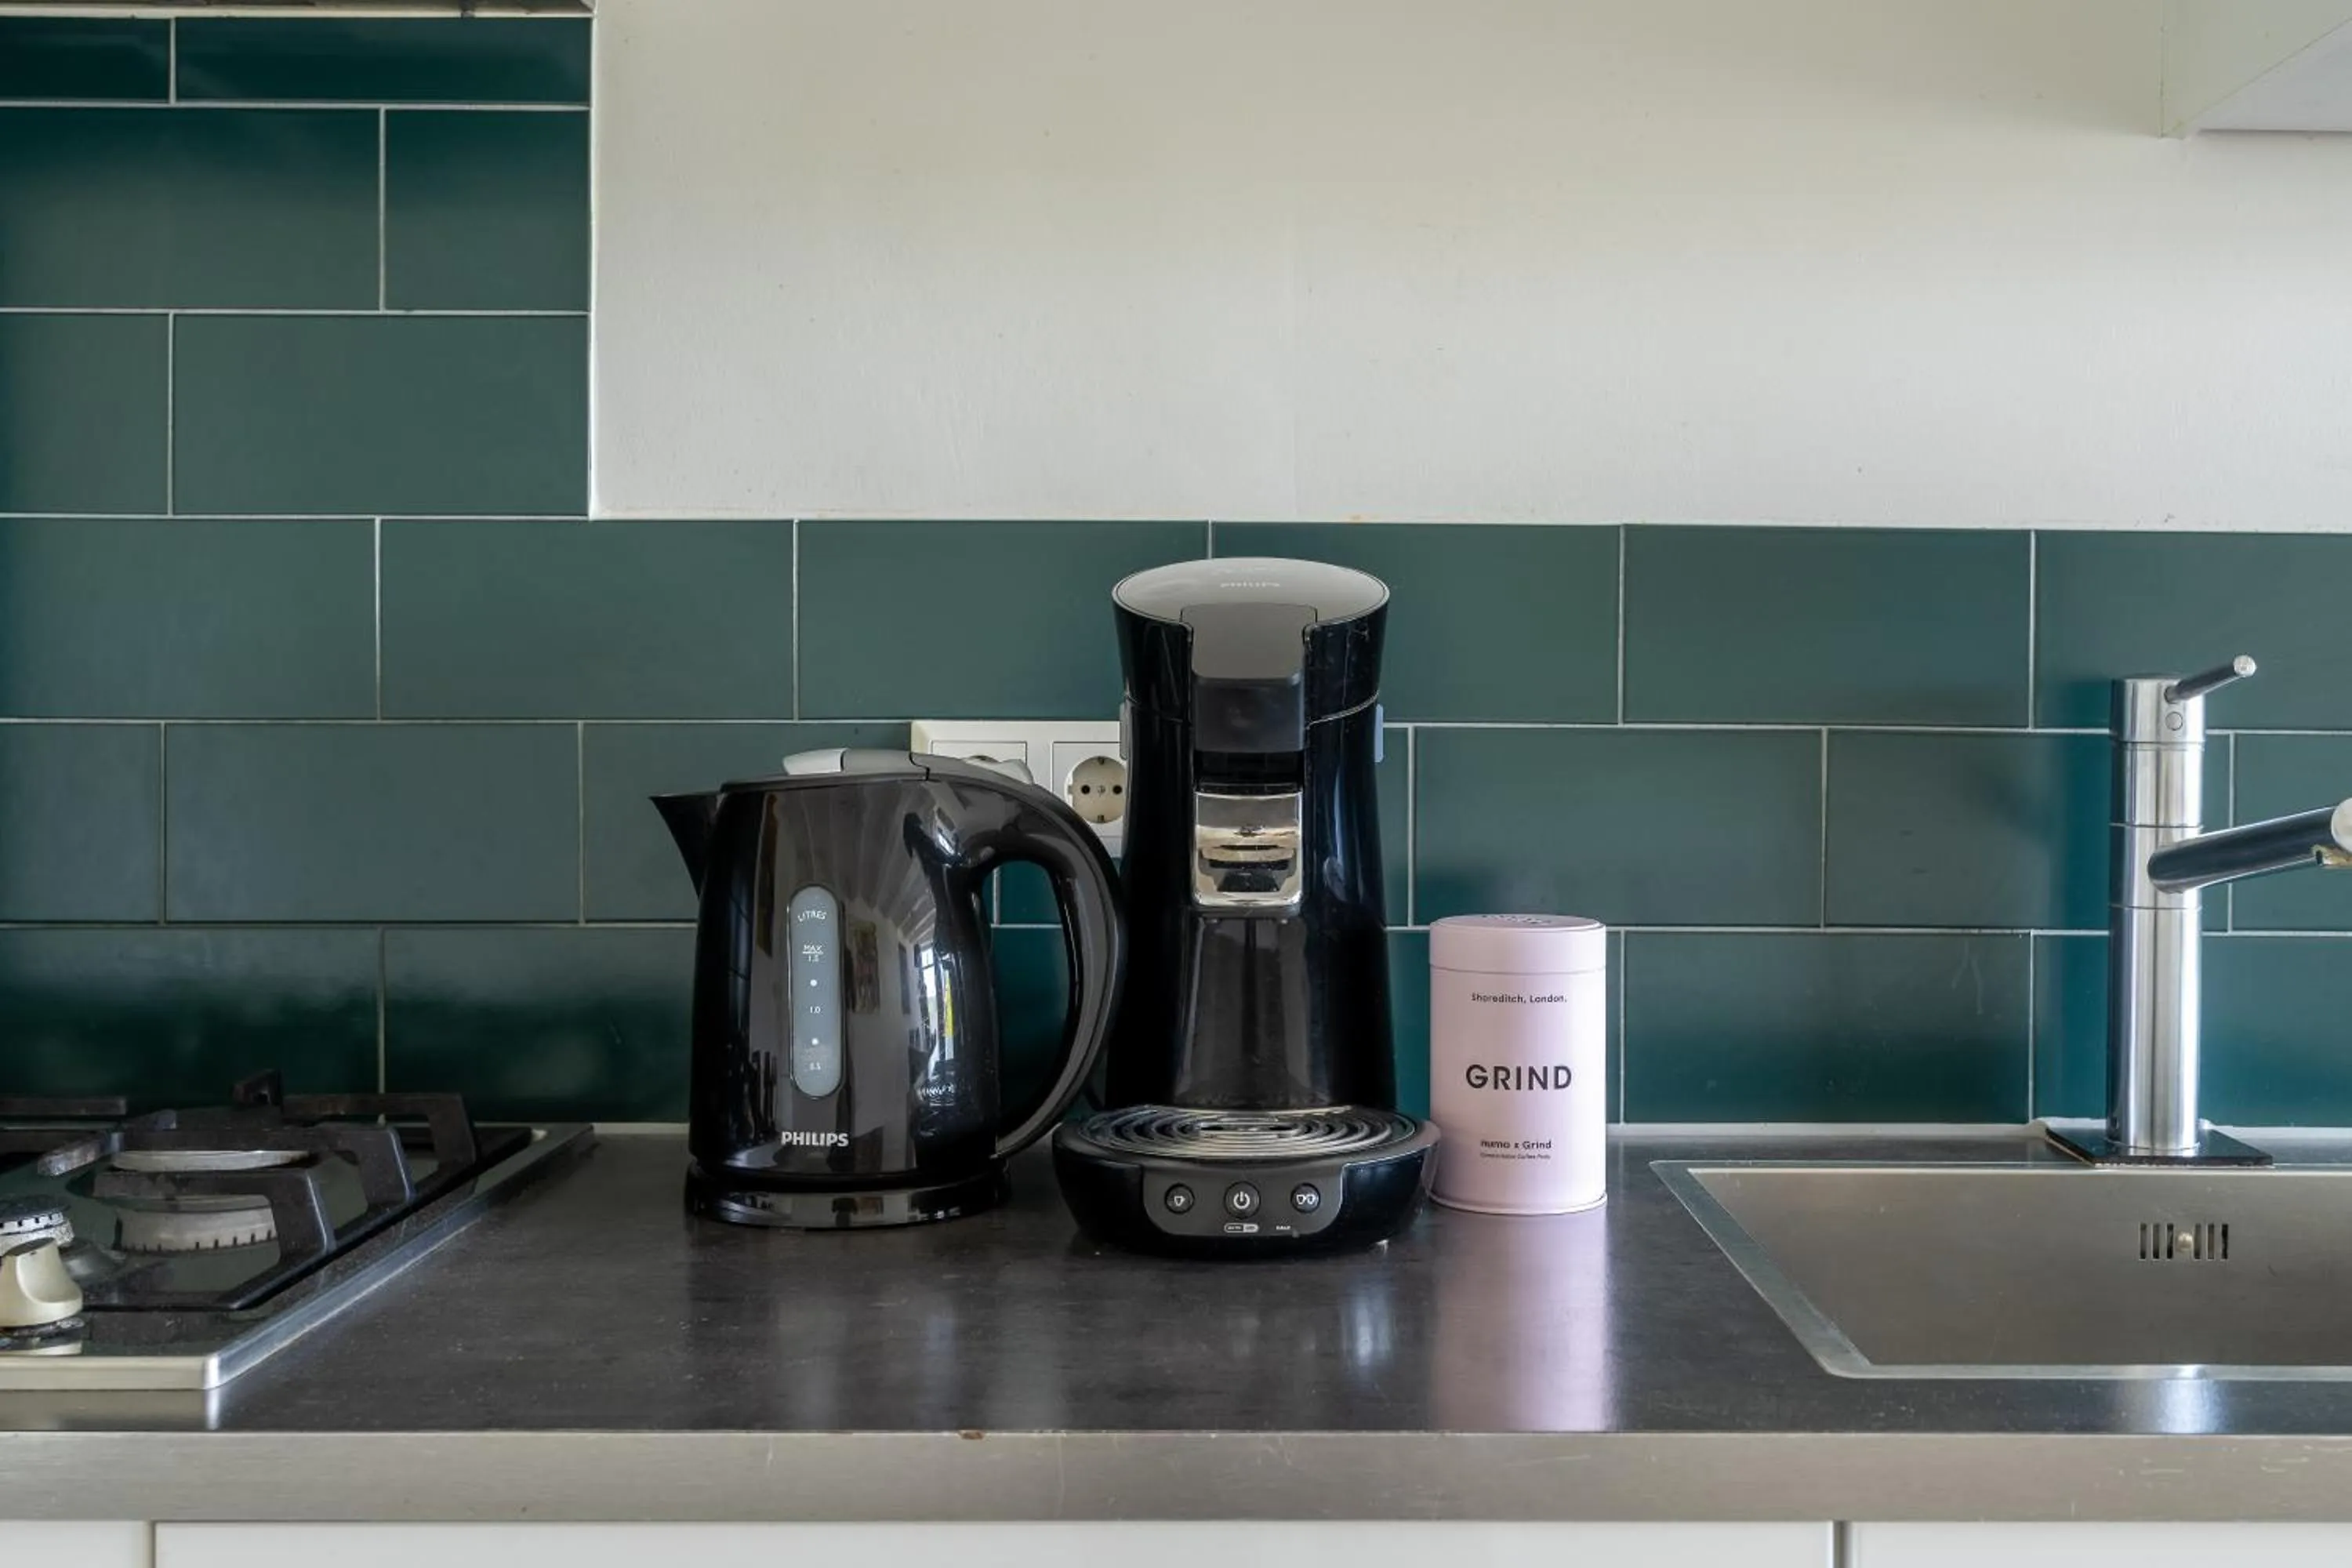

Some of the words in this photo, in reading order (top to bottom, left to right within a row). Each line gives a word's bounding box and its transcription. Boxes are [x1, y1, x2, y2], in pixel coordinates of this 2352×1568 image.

[797, 910, 827, 922] LITRES
[804, 944, 822, 954] MAX
[1471, 992, 1526, 1004] Shoreditch,
[1530, 993, 1567, 1004] London.
[1465, 1064, 1572, 1091] GRIND
[781, 1131, 849, 1147] PHILIPS
[1522, 1140, 1552, 1149] Grind
